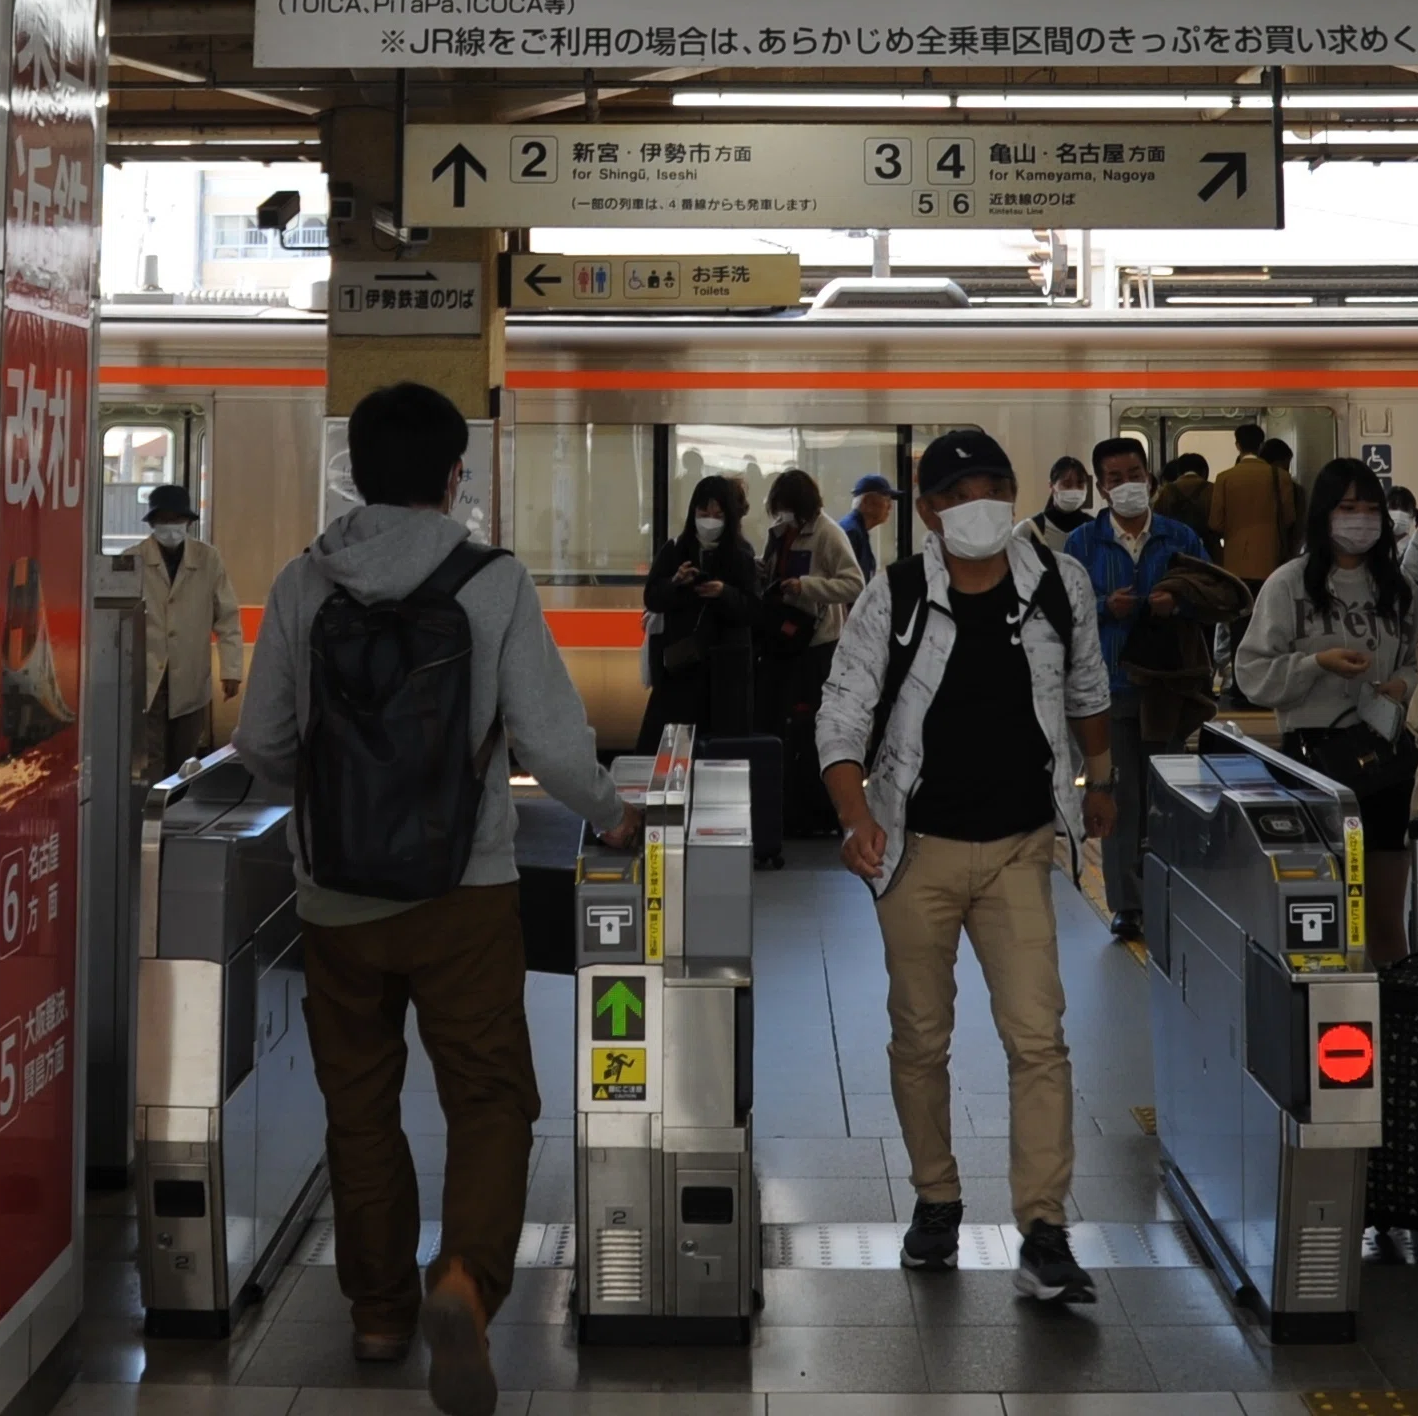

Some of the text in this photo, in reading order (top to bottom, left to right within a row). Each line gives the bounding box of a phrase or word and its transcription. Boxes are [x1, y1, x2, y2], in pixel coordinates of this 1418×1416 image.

[521, 142, 548, 178] 2
[874, 142, 966, 180] 3 4
[990, 143, 1165, 164] 亀山・名古屋方面
[573, 168, 591, 179] for
[657, 169, 697, 180] Iseshi
[989, 169, 1155, 183] for Kameyama, Nagoya
[918, 193, 969, 214] 5 6
[990, 193, 1076, 205] 近鉄線のりば
[692, 266, 750, 283] お手洗
[344, 289, 474, 310] 1 伊勢鉄道のりば
[693, 286, 729, 296] Toilets
[4, 362, 80, 510] 改札
[28, 833, 59, 883] 名古屋
[3, 863, 18, 943] 6
[0, 1033, 16, 1116] 5
[612, 1210, 627, 1224] 2
[1318, 1207, 1324, 1221] 1
[175, 1255, 189, 1270] 2
[704, 1262, 710, 1276] 1
